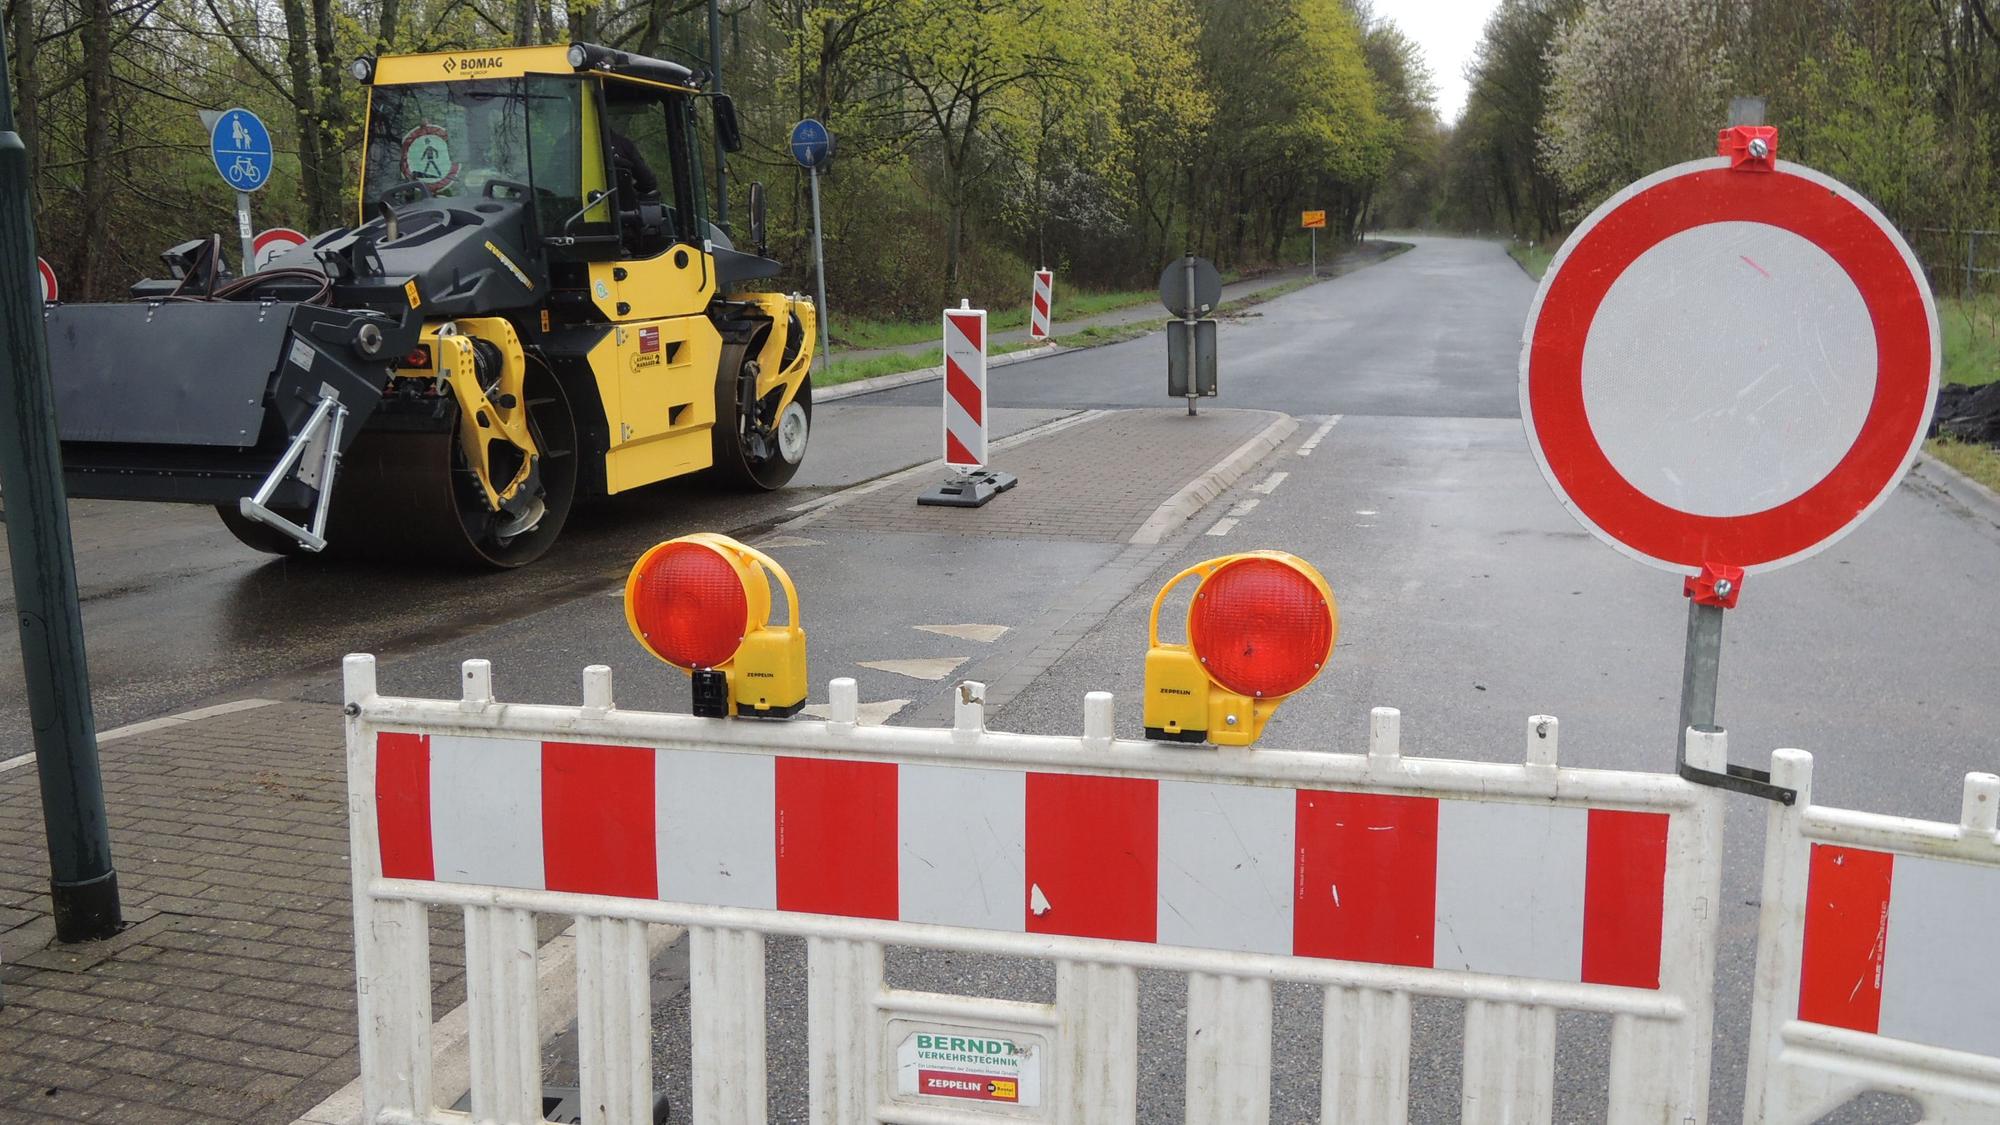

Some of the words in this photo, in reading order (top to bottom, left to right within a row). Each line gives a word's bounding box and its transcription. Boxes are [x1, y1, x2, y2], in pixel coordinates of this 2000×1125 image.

[460, 56, 503, 70] BOMAG
[654, 354, 660, 365] 2
[1160, 688, 1191, 696] ZEPPELIN
[917, 1035, 1015, 1056] BERNDT
[918, 1051, 1018, 1067] VERKEHRSTECHNIK
[928, 1078, 981, 1092] ZEPPELIN
